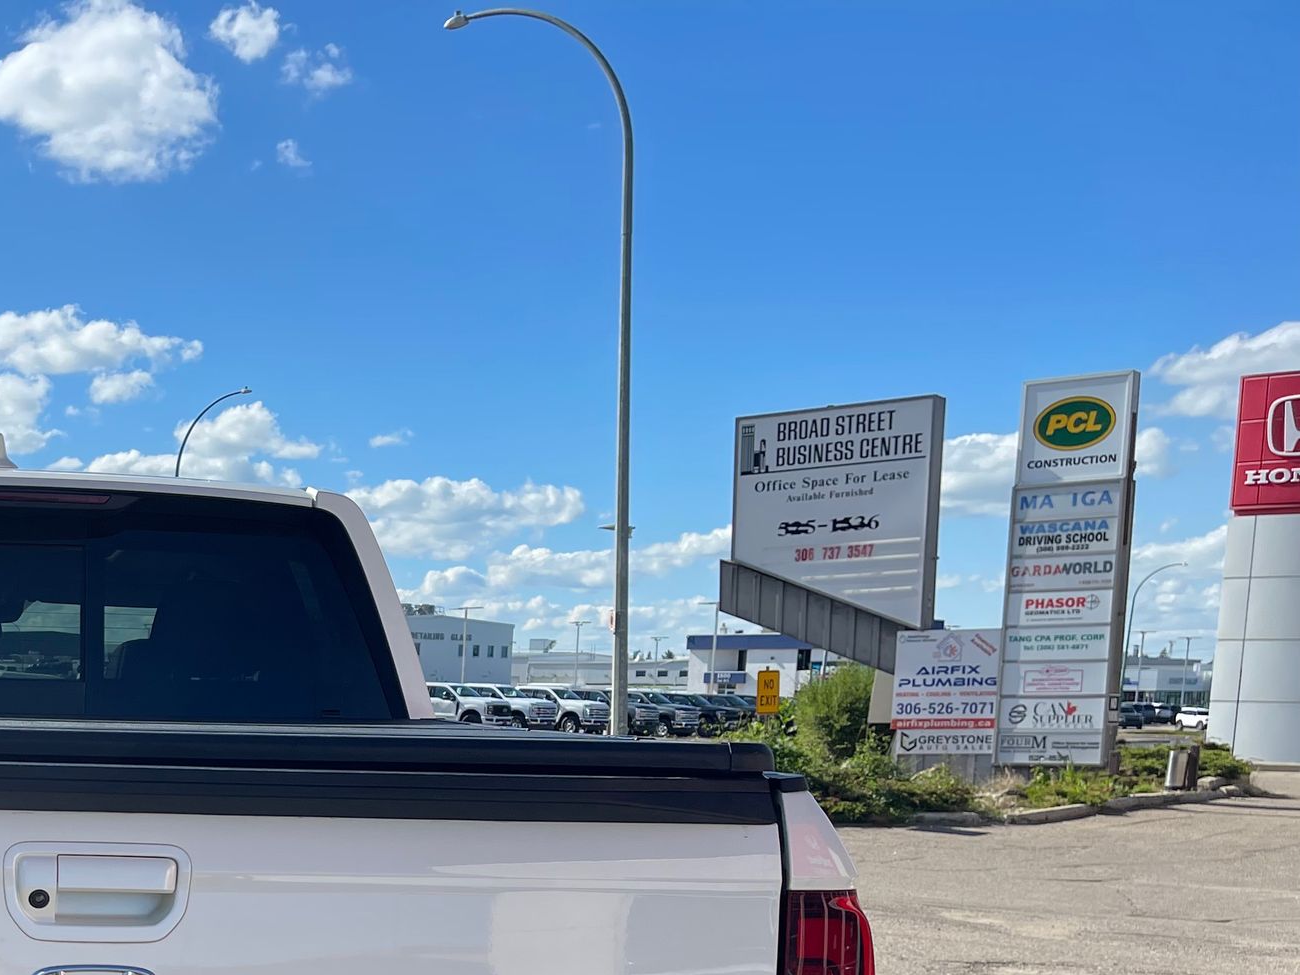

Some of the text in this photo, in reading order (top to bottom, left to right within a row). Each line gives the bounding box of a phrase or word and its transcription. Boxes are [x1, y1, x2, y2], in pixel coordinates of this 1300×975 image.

[777, 410, 896, 442] BROAD STREET
[1045, 410, 1102, 436] PCL
[776, 433, 923, 467] BUSINESS CENTRE
[1027, 454, 1117, 470] CONSTRUCTION
[754, 470, 910, 493] Office Space For Lease
[786, 487, 874, 503] Available Furnished
[1019, 519, 1110, 535] WASCANA
[1018, 531, 1109, 547] DRIVING SCHOOL
[794, 544, 874, 562] 306 737 3547
[1011, 561, 1113, 577] GARDAWORLD
[1024, 597, 1086, 609] PHASOR
[1034, 634, 1051, 642] CPA
[916, 665, 980, 676] AIRFIX
[763, 679, 775, 689] NO
[898, 677, 997, 688] PLUMBING
[760, 695, 777, 706] EXIT
[896, 702, 994, 715] 306-526-7071
[896, 719, 991, 729] airfixplumbing.ca
[918, 735, 992, 745] GREYSTONE
